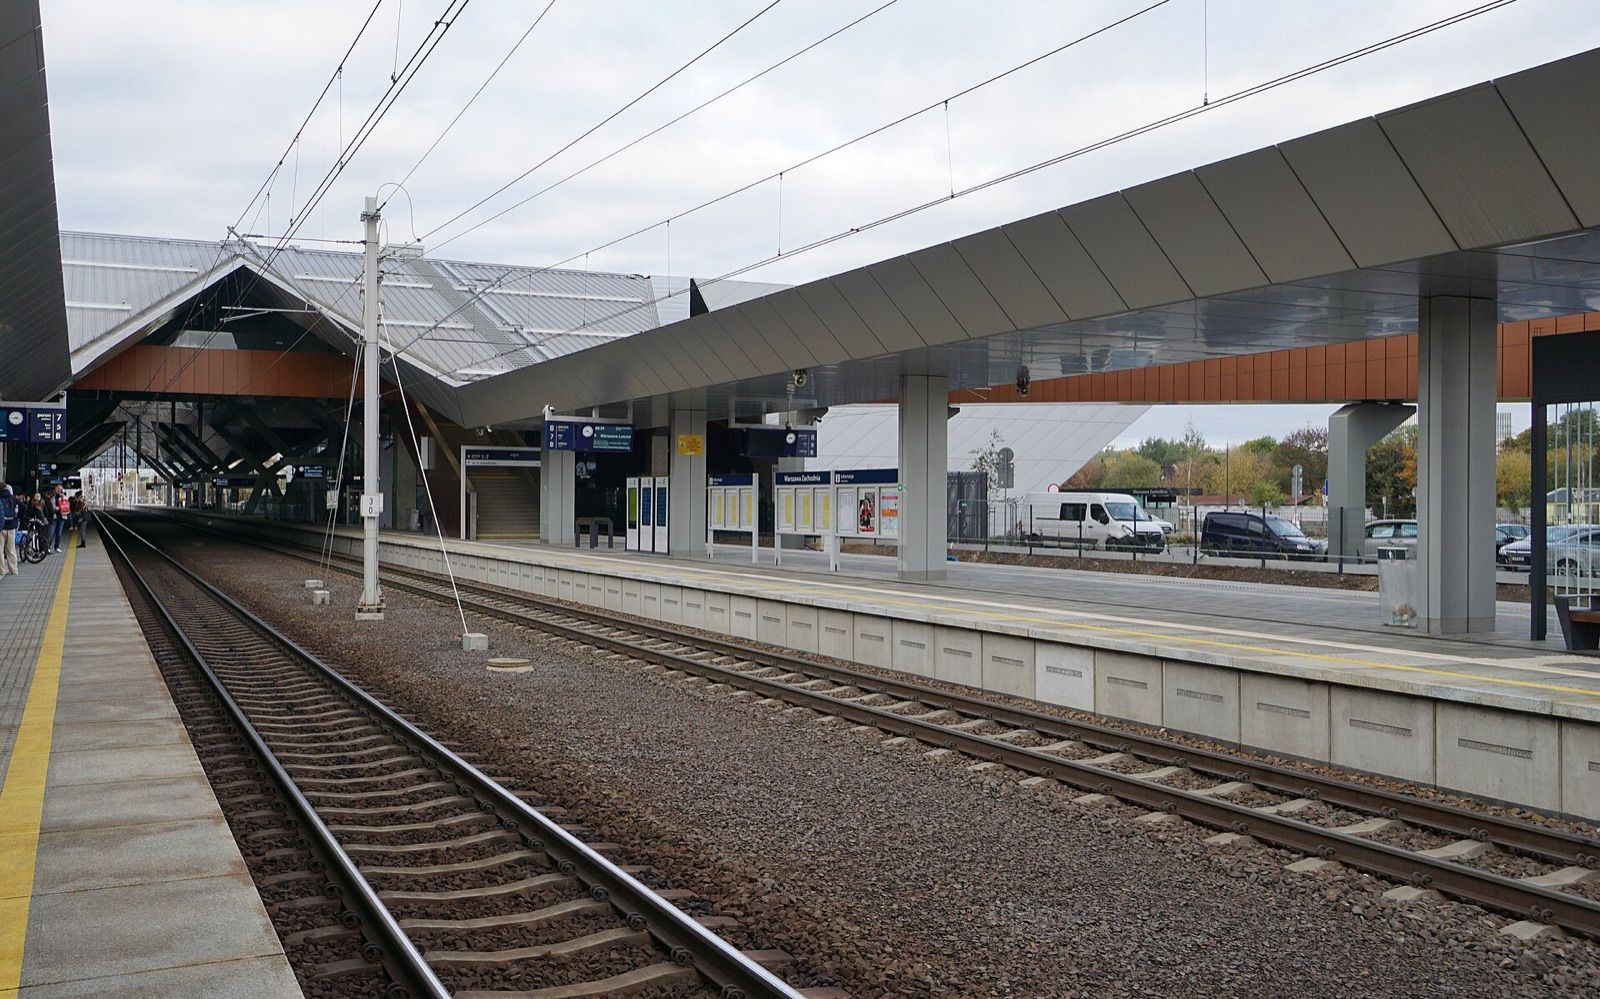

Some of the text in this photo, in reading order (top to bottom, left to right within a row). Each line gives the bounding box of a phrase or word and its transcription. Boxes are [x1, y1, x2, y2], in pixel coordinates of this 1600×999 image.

[56, 413, 62, 421] 7
[368, 497, 374, 506] 3
[368, 506, 374, 515] 0
